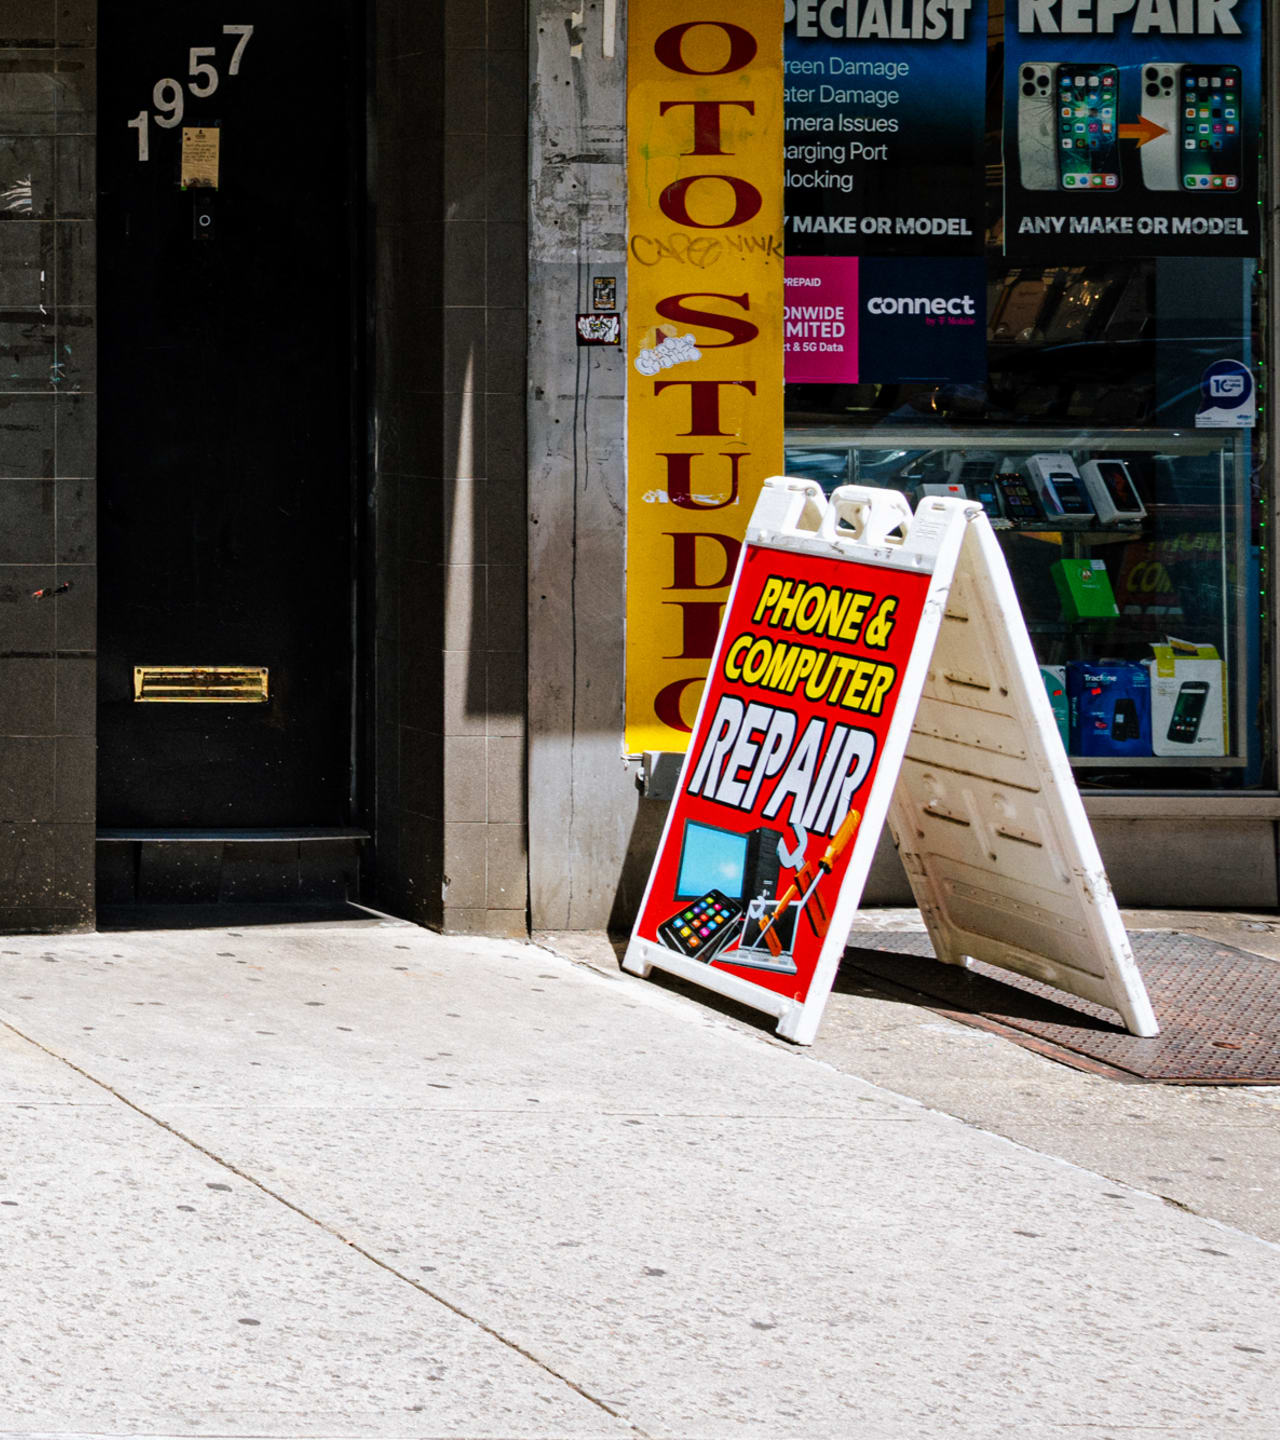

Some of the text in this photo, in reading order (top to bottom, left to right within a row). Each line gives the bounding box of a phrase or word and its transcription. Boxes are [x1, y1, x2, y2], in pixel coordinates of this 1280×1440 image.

[784, 56, 910, 81] reen Damage
[126, 24, 254, 162] 1957
[784, 84, 900, 109] ater Damage
[785, 112, 900, 133] mera Issues
[784, 141, 889, 164] arging Port
[784, 168, 854, 193] locking
[792, 215, 857, 234] MAKE
[860, 216, 893, 234] OR
[895, 216, 973, 237] MODEL
[1017, 215, 1249, 236] ANY MAKE OR MODEL
[783, 305, 845, 321] ONWIDE
[866, 294, 976, 316] connect
[792, 341, 844, 353] & 5G Data
[751, 574, 896, 650] PHONE &
[723, 635, 898, 716] COMPUTER
[687, 694, 877, 840] REPAIR
